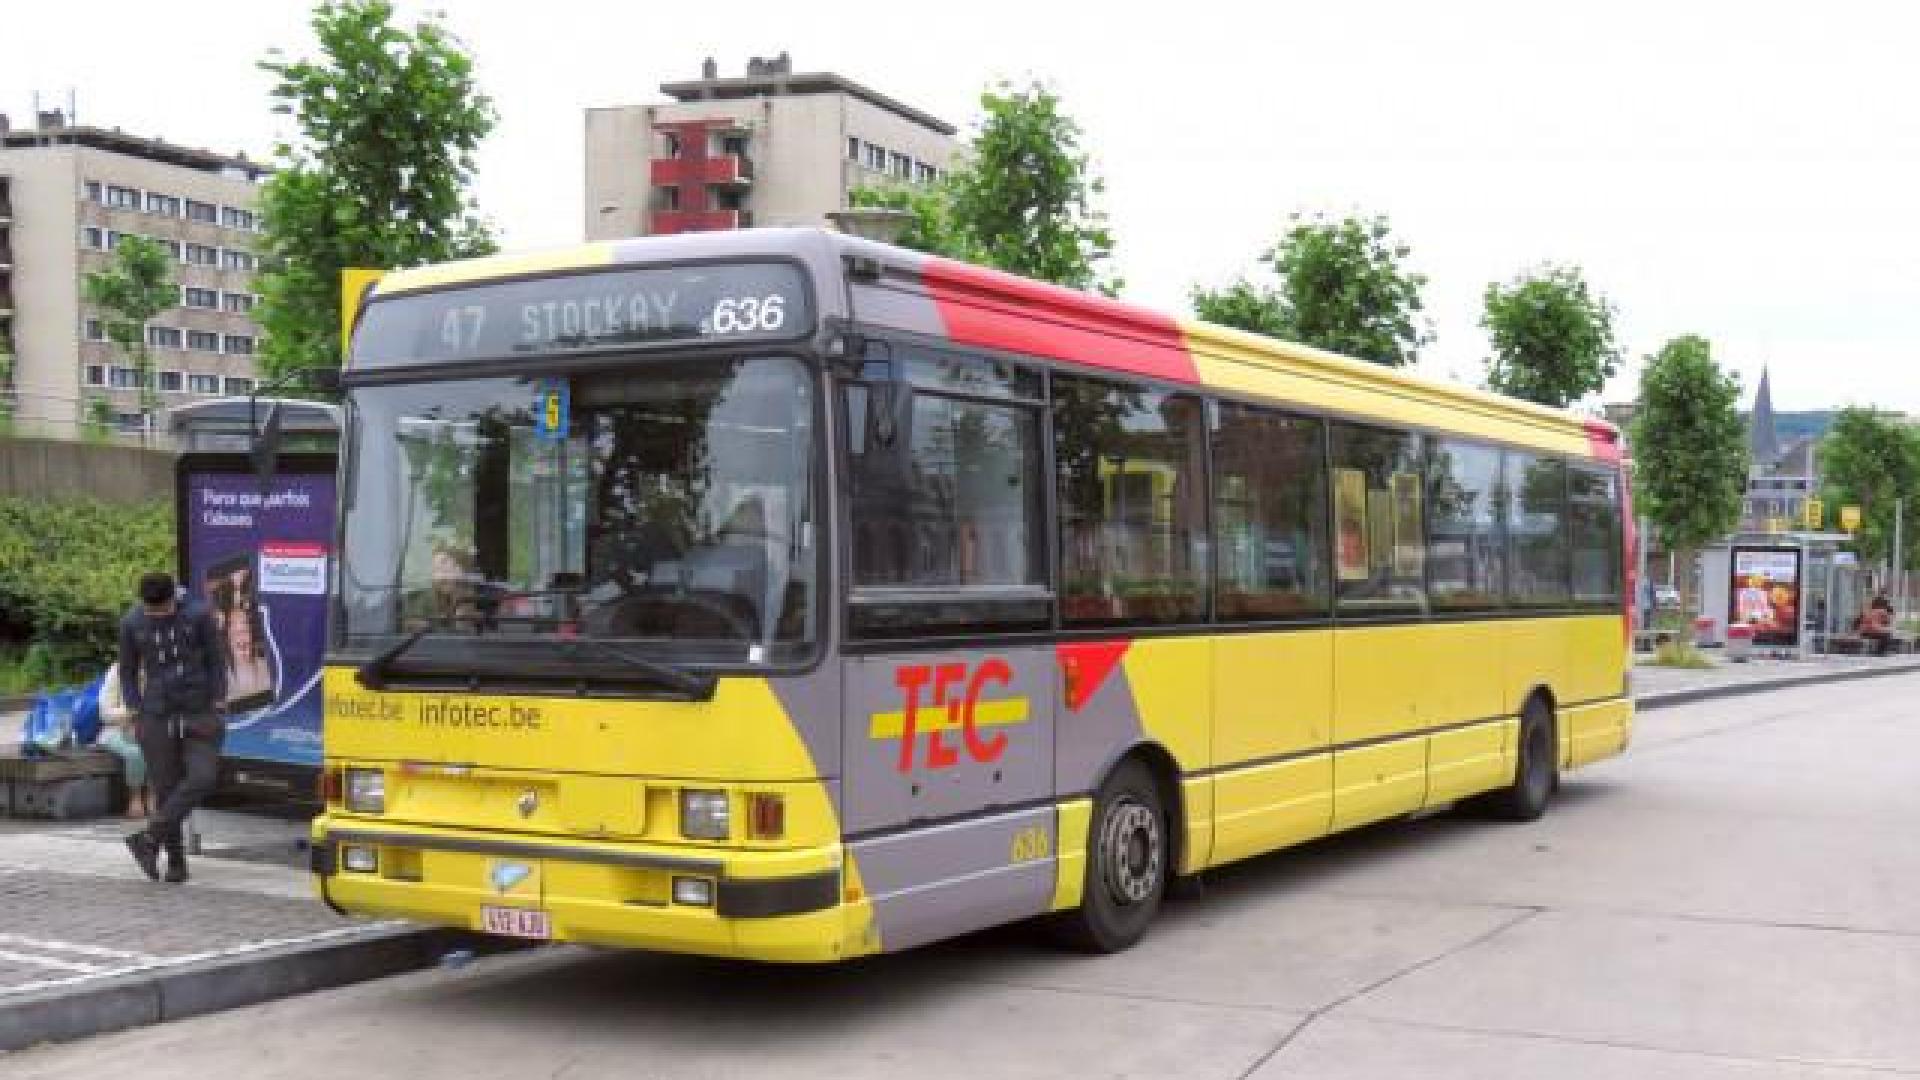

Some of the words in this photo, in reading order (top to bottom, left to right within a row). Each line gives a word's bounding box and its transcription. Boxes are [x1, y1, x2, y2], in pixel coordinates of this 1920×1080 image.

[440, 306, 486, 351] 47
[522, 289, 678, 342] STOCKAY
[712, 293, 786, 334] 636
[545, 394, 560, 430] 5
[418, 697, 541, 729] infotec.be
[895, 658, 1013, 774] TEC
[1011, 825, 1049, 862] 636
